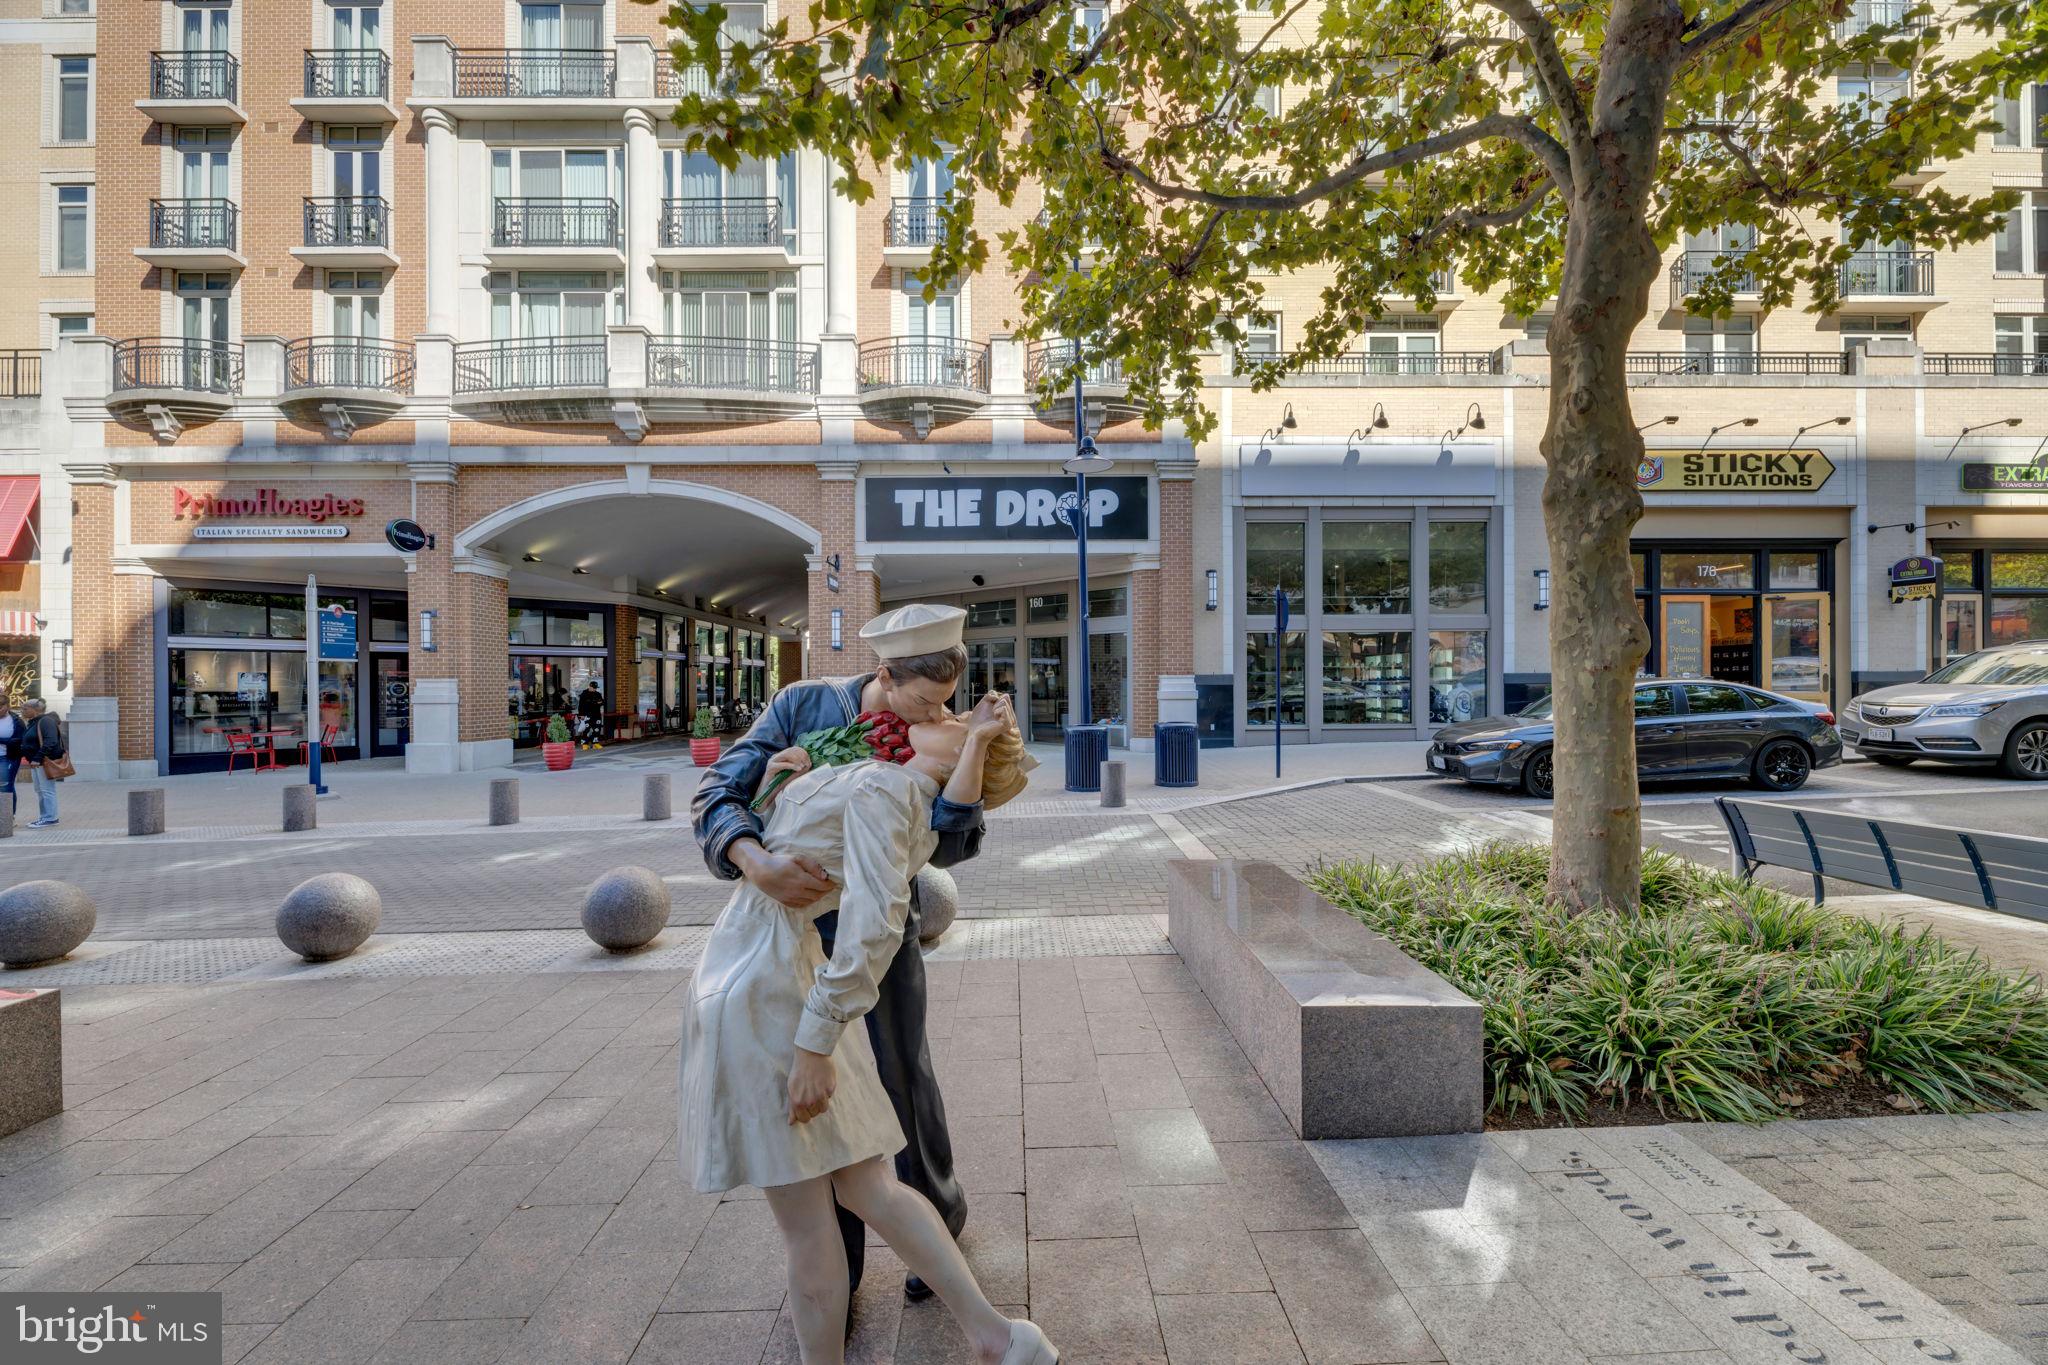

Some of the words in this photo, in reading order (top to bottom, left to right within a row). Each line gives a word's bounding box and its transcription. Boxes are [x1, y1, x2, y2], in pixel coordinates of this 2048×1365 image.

[1683, 453, 1814, 473] STICKY
[1683, 474, 1813, 487] SITUATIONS
[174, 486, 365, 523] PrimoHoagies
[895, 488, 982, 528] THE
[995, 488, 1120, 528] DROP
[197, 528, 233, 536] ITALIAN
[236, 528, 283, 536] SPECIALTY
[286, 528, 344, 536] SANDWICHES
[1029, 597, 1043, 608] 160
